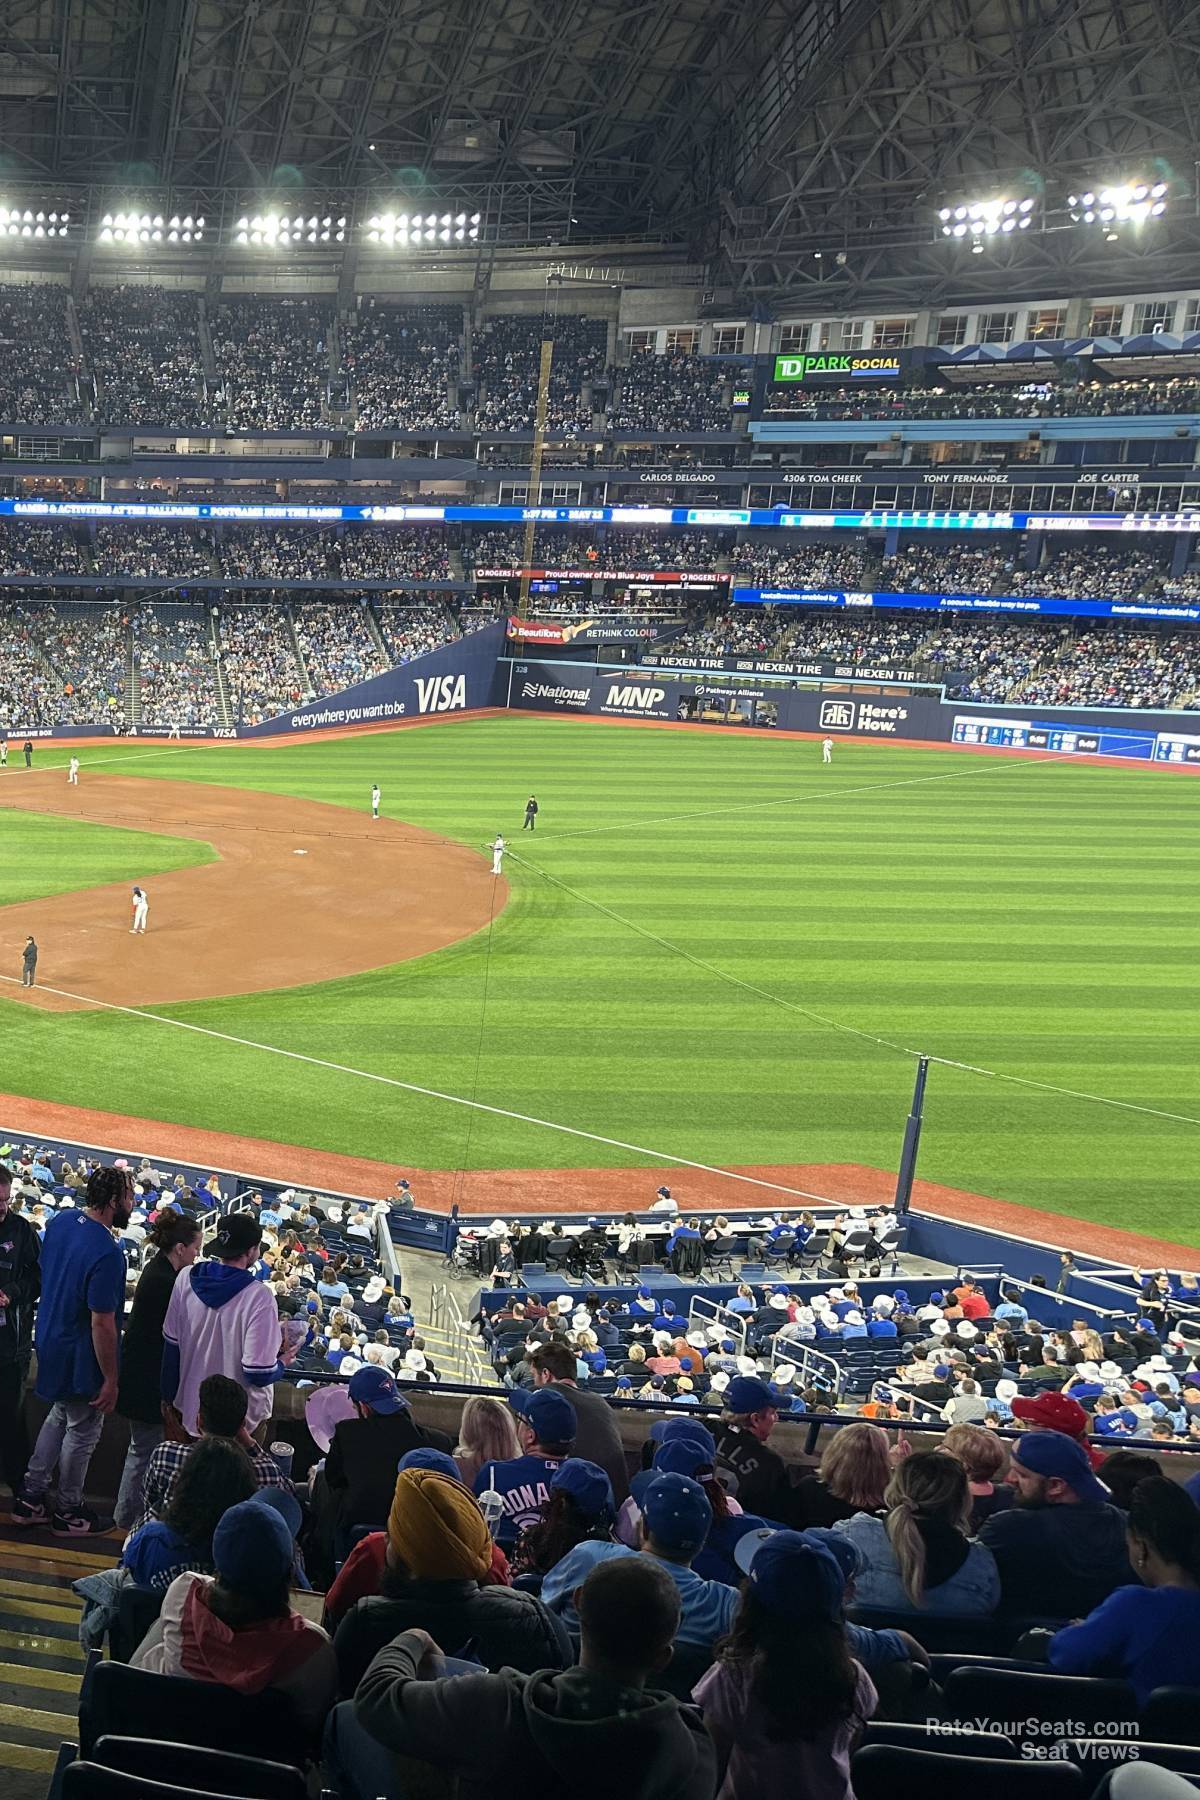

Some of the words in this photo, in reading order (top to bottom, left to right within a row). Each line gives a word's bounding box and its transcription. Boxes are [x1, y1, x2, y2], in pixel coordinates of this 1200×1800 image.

[778, 360, 801, 376] TD
[805, 356, 851, 370] PARK
[851, 358, 900, 369] SOCIAL
[640, 474, 673, 482] CARLOS
[675, 474, 715, 482] DELGADO
[783, 475, 806, 483] 4306
[808, 475, 829, 483] TOM
[831, 475, 862, 483] CHEEK
[922, 474, 950, 483] TONY
[952, 474, 1008, 483] FERNANDEZ
[1077, 474, 1097, 483] JOE
[1101, 474, 1139, 482] CARTER
[545, 570, 568, 578] Proud
[593, 571, 603, 579] of
[603, 571, 617, 579] the
[617, 572, 634, 580] Blue
[635, 573, 655, 581] Jays
[829, 594, 838, 603] by
[843, 593, 873, 606] VISA
[940, 598, 947, 606] A
[1000, 601, 1016, 610] way
[1016, 601, 1024, 609] to
[586, 628, 622, 638] RETHINK
[623, 628, 658, 638] COLOUR
[660, 657, 697, 667] NEXEN
[699, 658, 724, 669] TIRE
[756, 662, 794, 673] NEXEN
[795, 664, 822, 675] TIRE
[515, 665, 528, 674] 328
[855, 668, 894, 679] NEXEN
[606, 685, 665, 708] MNP
[705, 687, 737, 696] Pathways
[738, 689, 764, 697] Alliance
[291, 707, 345, 728] everywhere
[345, 708, 362, 723] you
[362, 704, 383, 717] want
[384, 704, 394, 716] to
[394, 701, 405, 714] be
[413, 674, 466, 713] VISA
[566, 699, 587, 707] Rental
[859, 704, 908, 720] Here's
[857, 717, 897, 732] How.
[112, 725, 138, 736] VA
[211, 727, 237, 738] VISA
[629, 1232, 642, 1242] 26
